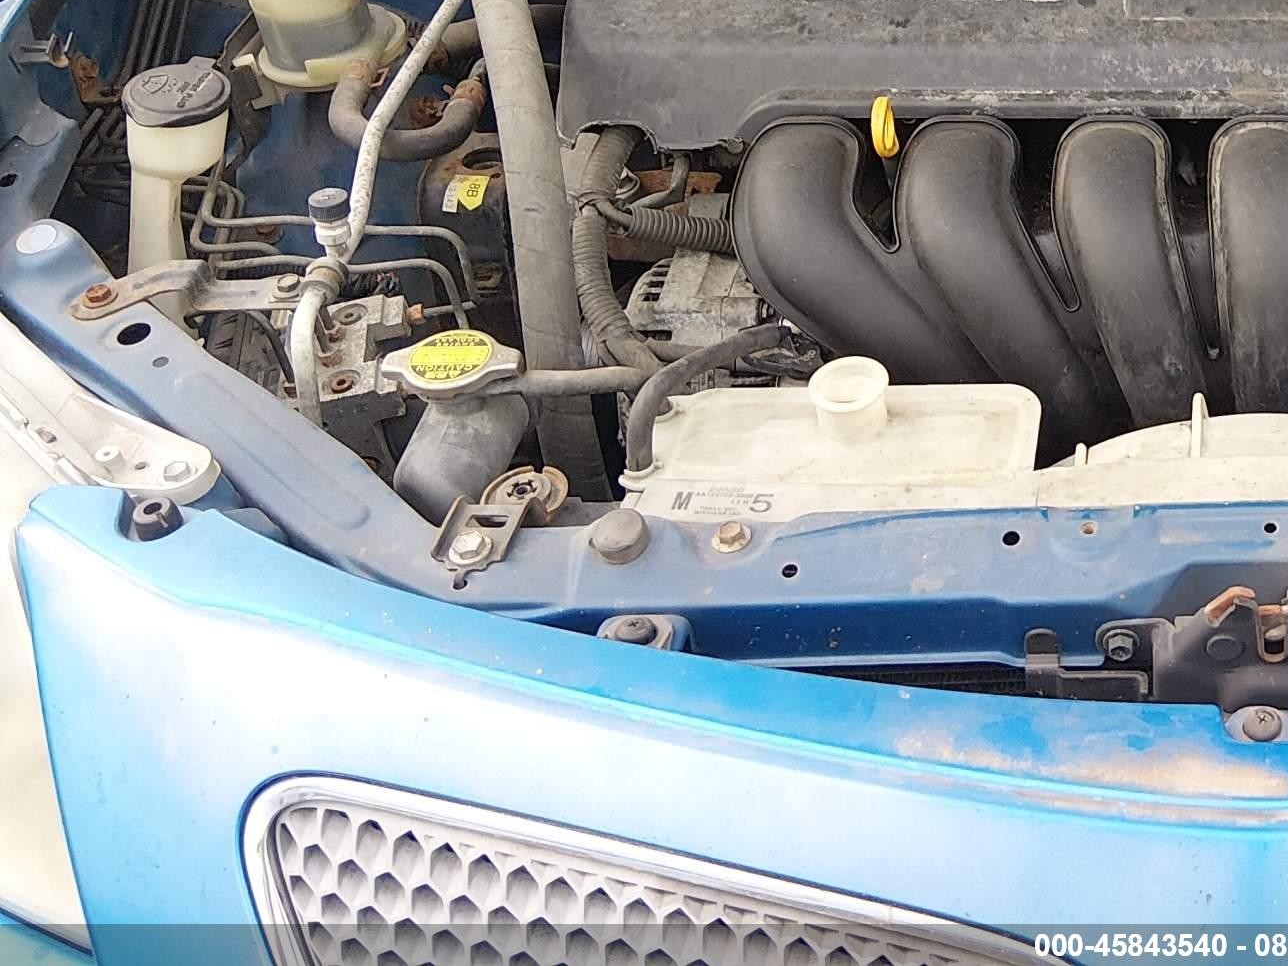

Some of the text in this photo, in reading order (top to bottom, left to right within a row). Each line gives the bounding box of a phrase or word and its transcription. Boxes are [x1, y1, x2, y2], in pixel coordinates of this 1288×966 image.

[415, 363, 473, 372] CAUTION
[671, 491, 693, 511] M
[749, 493, 775, 513] 5
